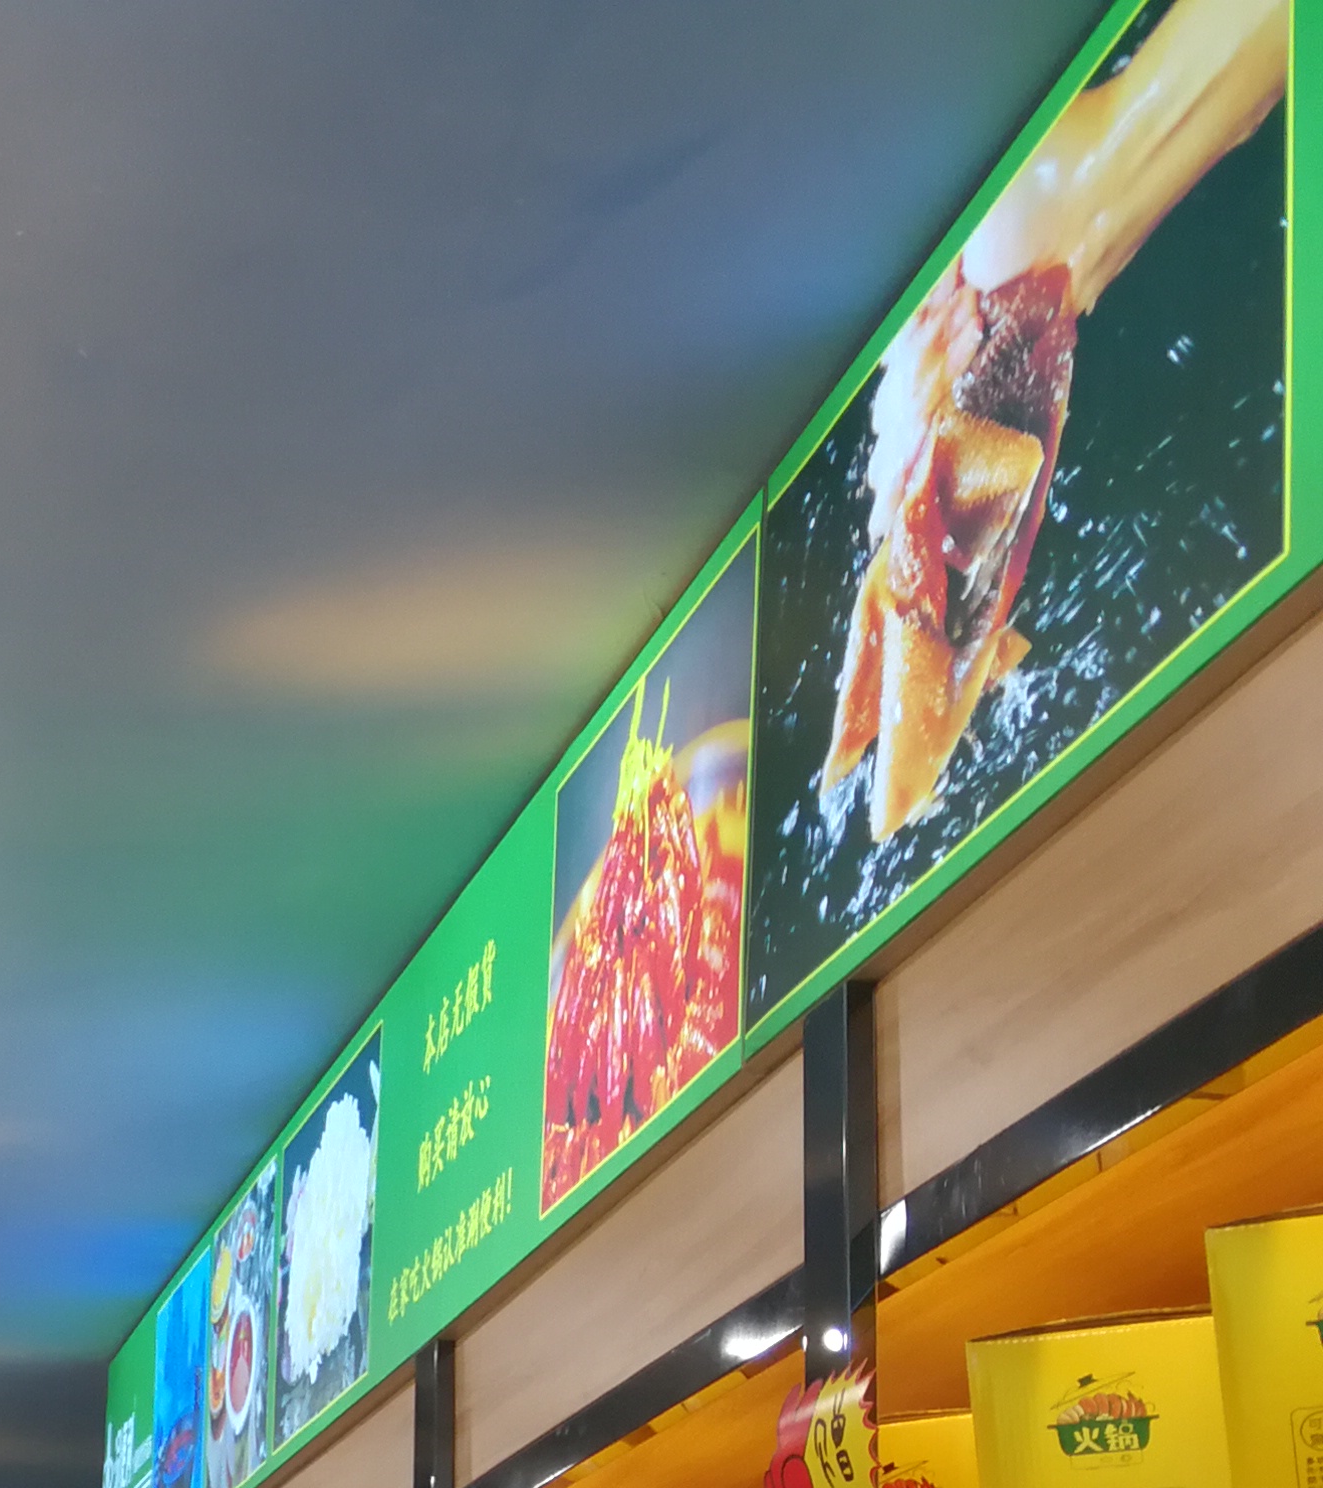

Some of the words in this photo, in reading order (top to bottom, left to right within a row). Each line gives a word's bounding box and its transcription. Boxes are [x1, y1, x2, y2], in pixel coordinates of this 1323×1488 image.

[422, 939, 496, 1075] 本店无假货
[417, 1074, 492, 1193] 购买请放心
[1074, 1418, 1140, 1454] 火锅
